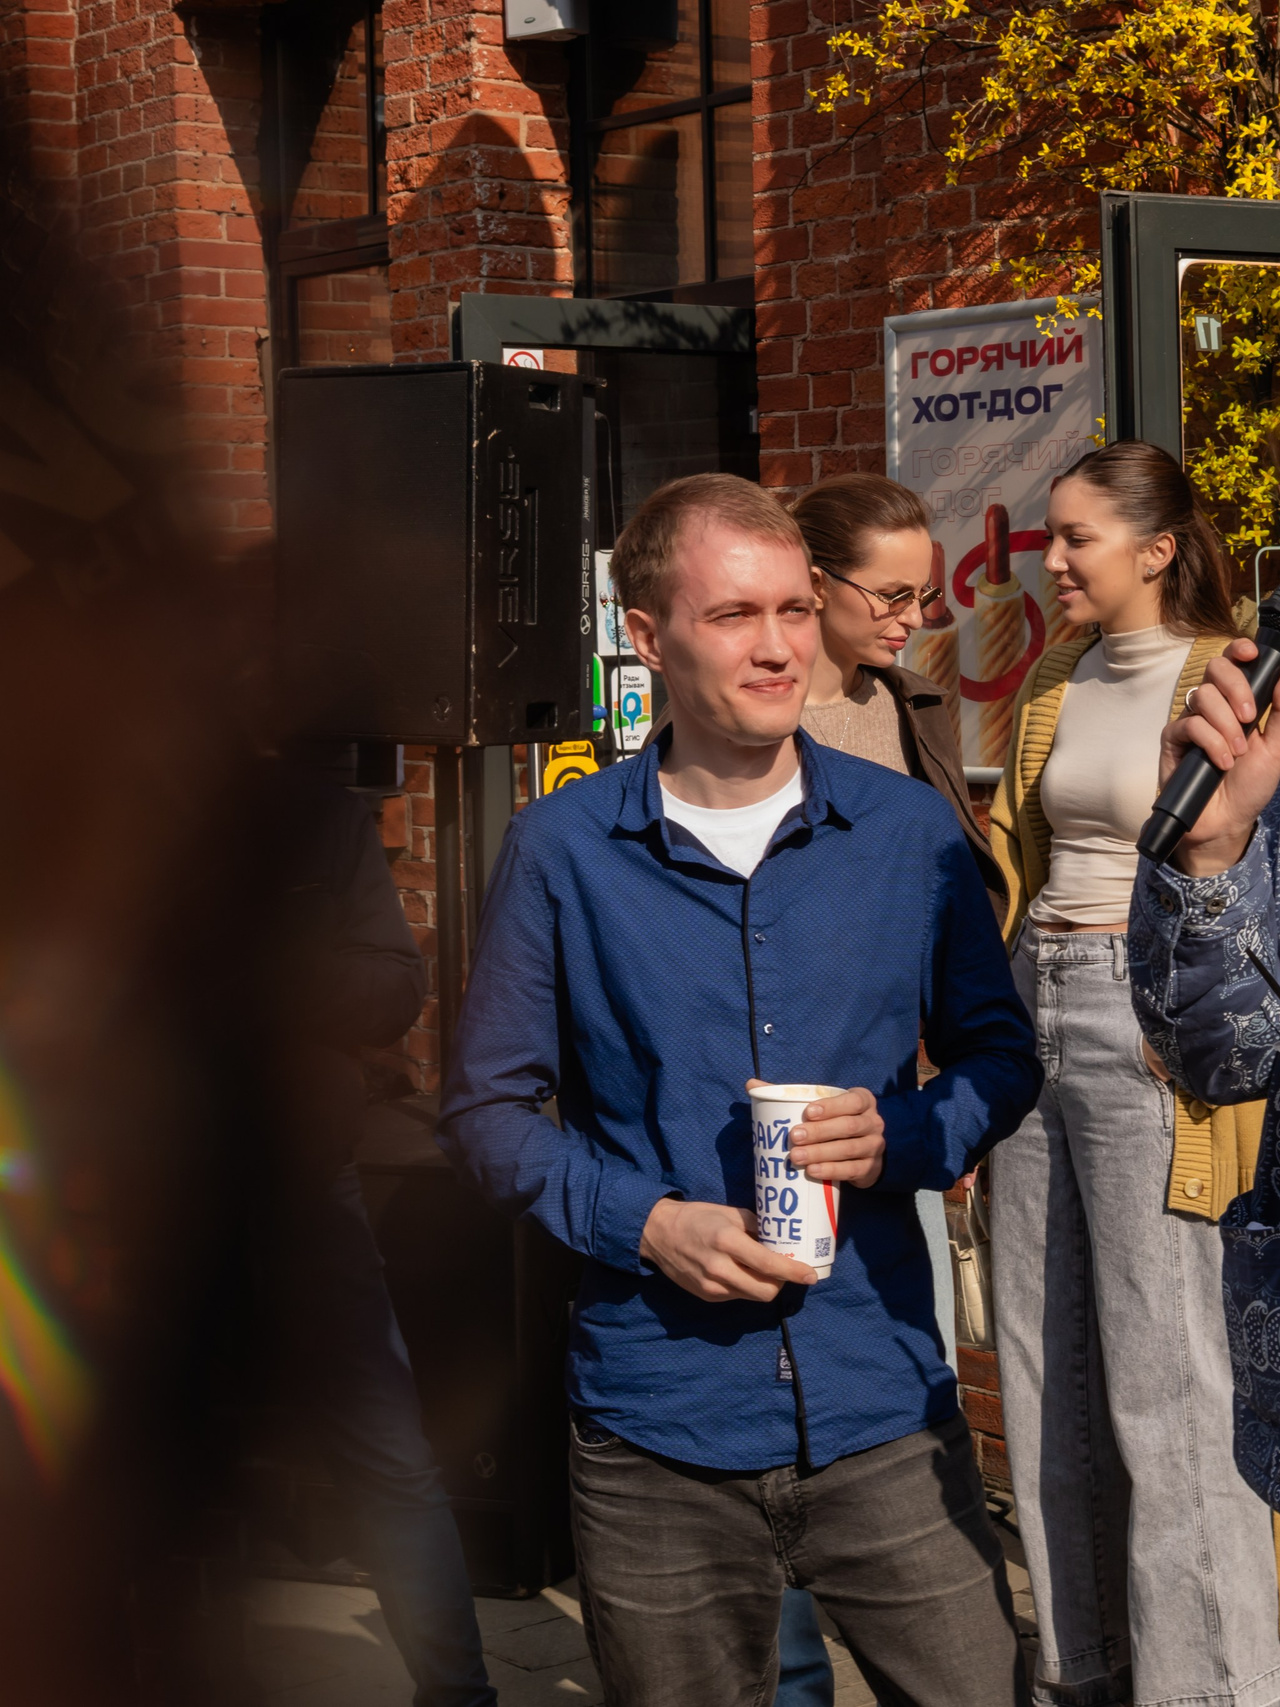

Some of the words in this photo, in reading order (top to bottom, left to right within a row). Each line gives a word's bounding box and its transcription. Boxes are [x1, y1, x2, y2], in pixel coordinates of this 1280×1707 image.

[910, 327, 1085, 380] ГОРЯЧИЙ
[912, 383, 1064, 425] ХОТ-ДОГ
[918, 486, 1002, 523] ДОГ
[624, 675, 640, 683] Рады
[625, 734, 641, 742] 2ГИС
